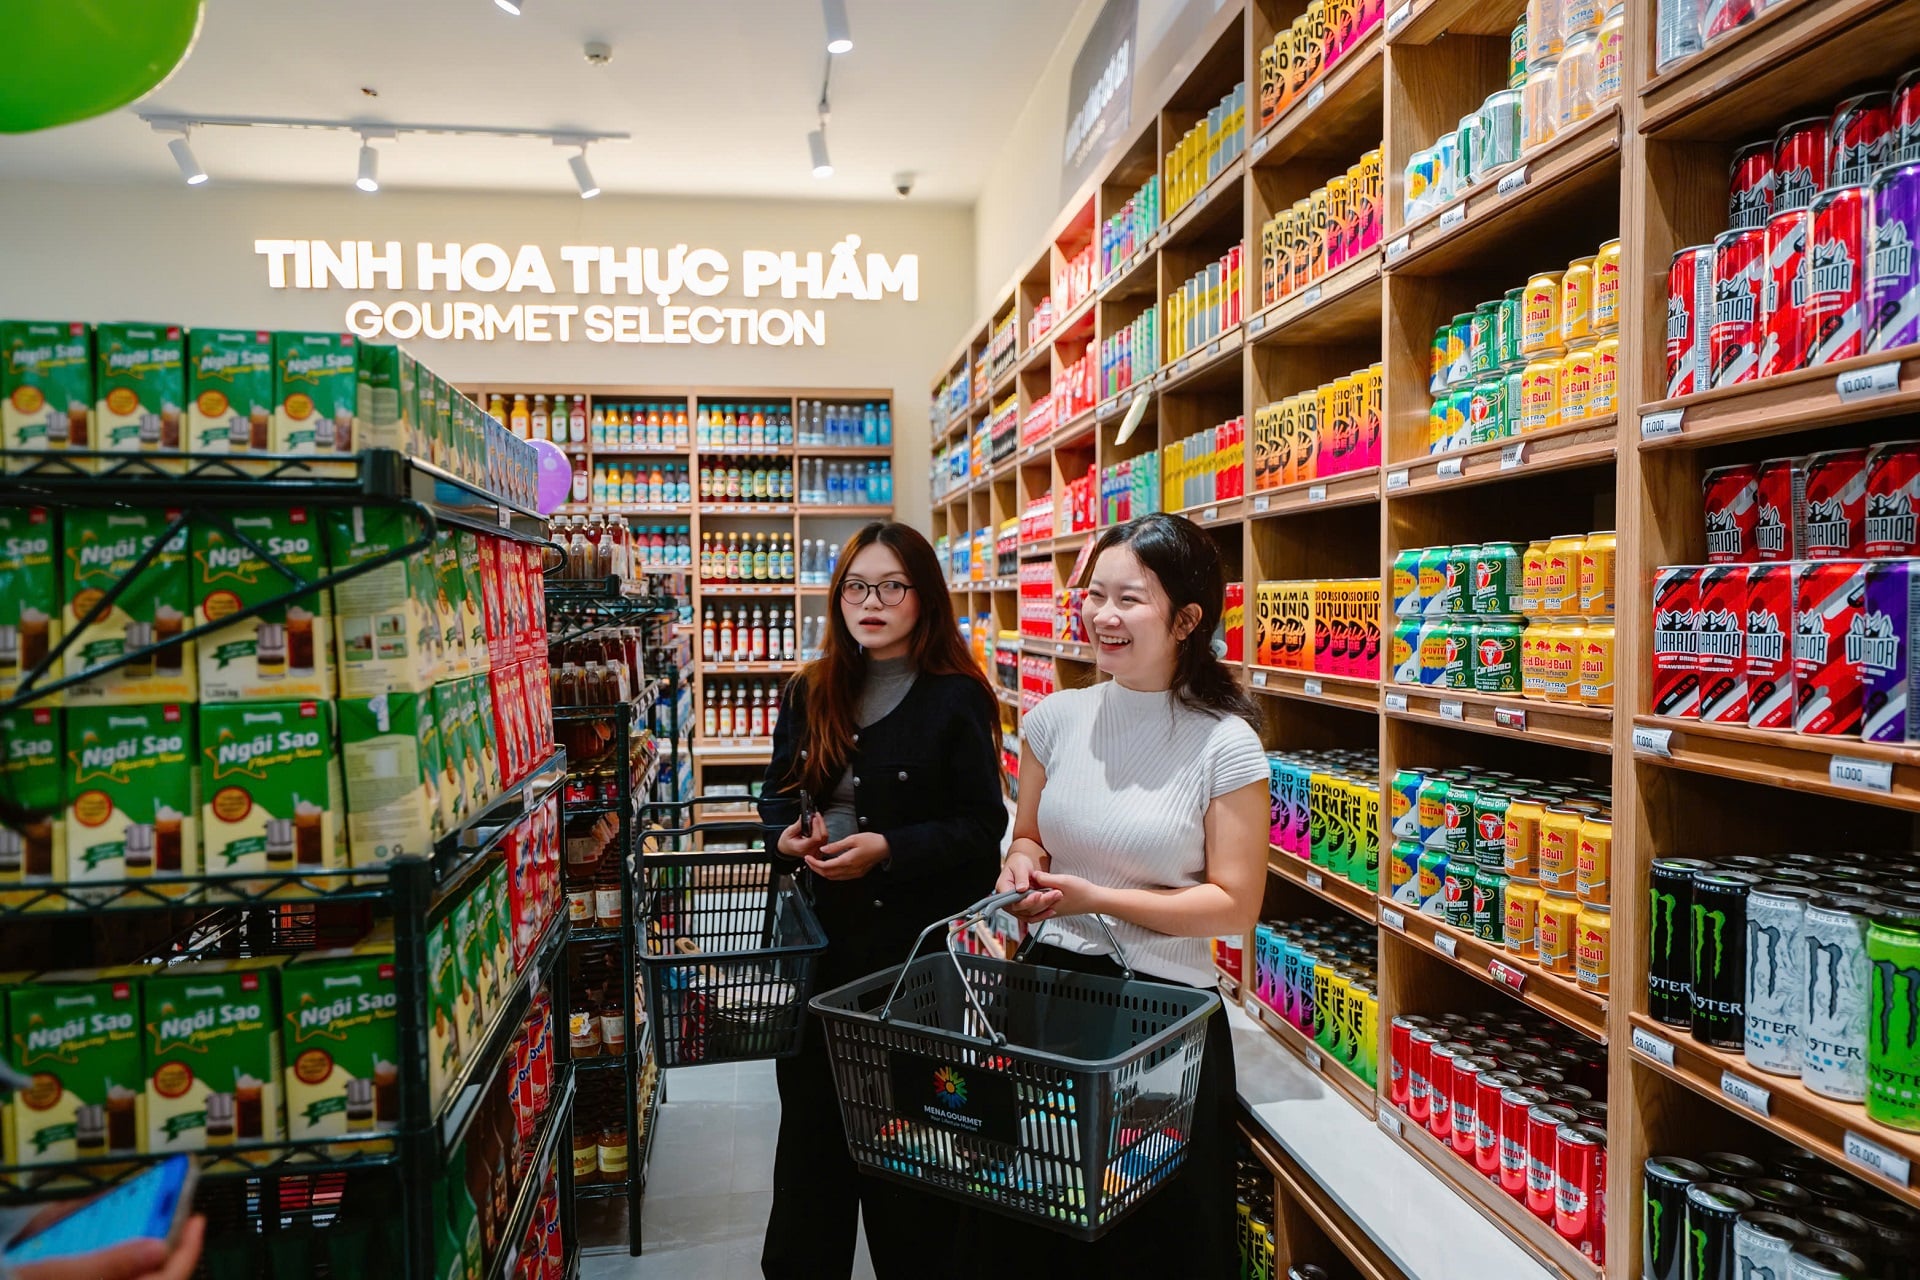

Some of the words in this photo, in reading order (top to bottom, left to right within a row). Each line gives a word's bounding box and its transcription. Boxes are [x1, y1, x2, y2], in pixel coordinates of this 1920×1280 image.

[254, 239, 402, 289] TINH
[416, 241, 556, 293] HOA
[560, 243, 729, 307] THỰC
[742, 234, 919, 301] PHẨM
[1599, 279, 1620, 294] Bull
[344, 299, 579, 342] GOURMET
[585, 303, 826, 346] SELECTION
[1570, 380, 1590, 393] Bull
[1842, 375, 1873, 394] 10.000
[1532, 391, 1552, 403] Bull
[142, 534, 184, 554] So
[268, 537, 311, 556] Sao
[1527, 576, 1542, 587] Bull
[1549, 574, 1566, 585] Bull
[1554, 659, 1573, 670] Bull
[1586, 661, 1604, 672] Bull
[219, 733, 274, 765] Ngôi
[277, 730, 320, 752] Sao
[1635, 734, 1653, 749] 11.000
[82, 736, 139, 770] Ngôi
[141, 734, 183, 756] Sao
[1835, 764, 1863, 782] 11.000
[1546, 848, 1564, 861] Bull
[1579, 857, 1595, 871] Bull
[1508, 914, 1524, 929] Bull
[1542, 929, 1558, 944] Bull
[1585, 948, 1604, 961] Bull
[300, 996, 354, 1029] Ngôi
[357, 992, 398, 1013] Sao
[161, 1007, 216, 1041] Ngôi
[219, 1004, 261, 1025] Sao
[28, 1016, 86, 1052] Ngôi
[90, 1013, 133, 1035] Sao
[923, 1104, 947, 1118] MENA
[946, 1110, 983, 1127] GOURMET
